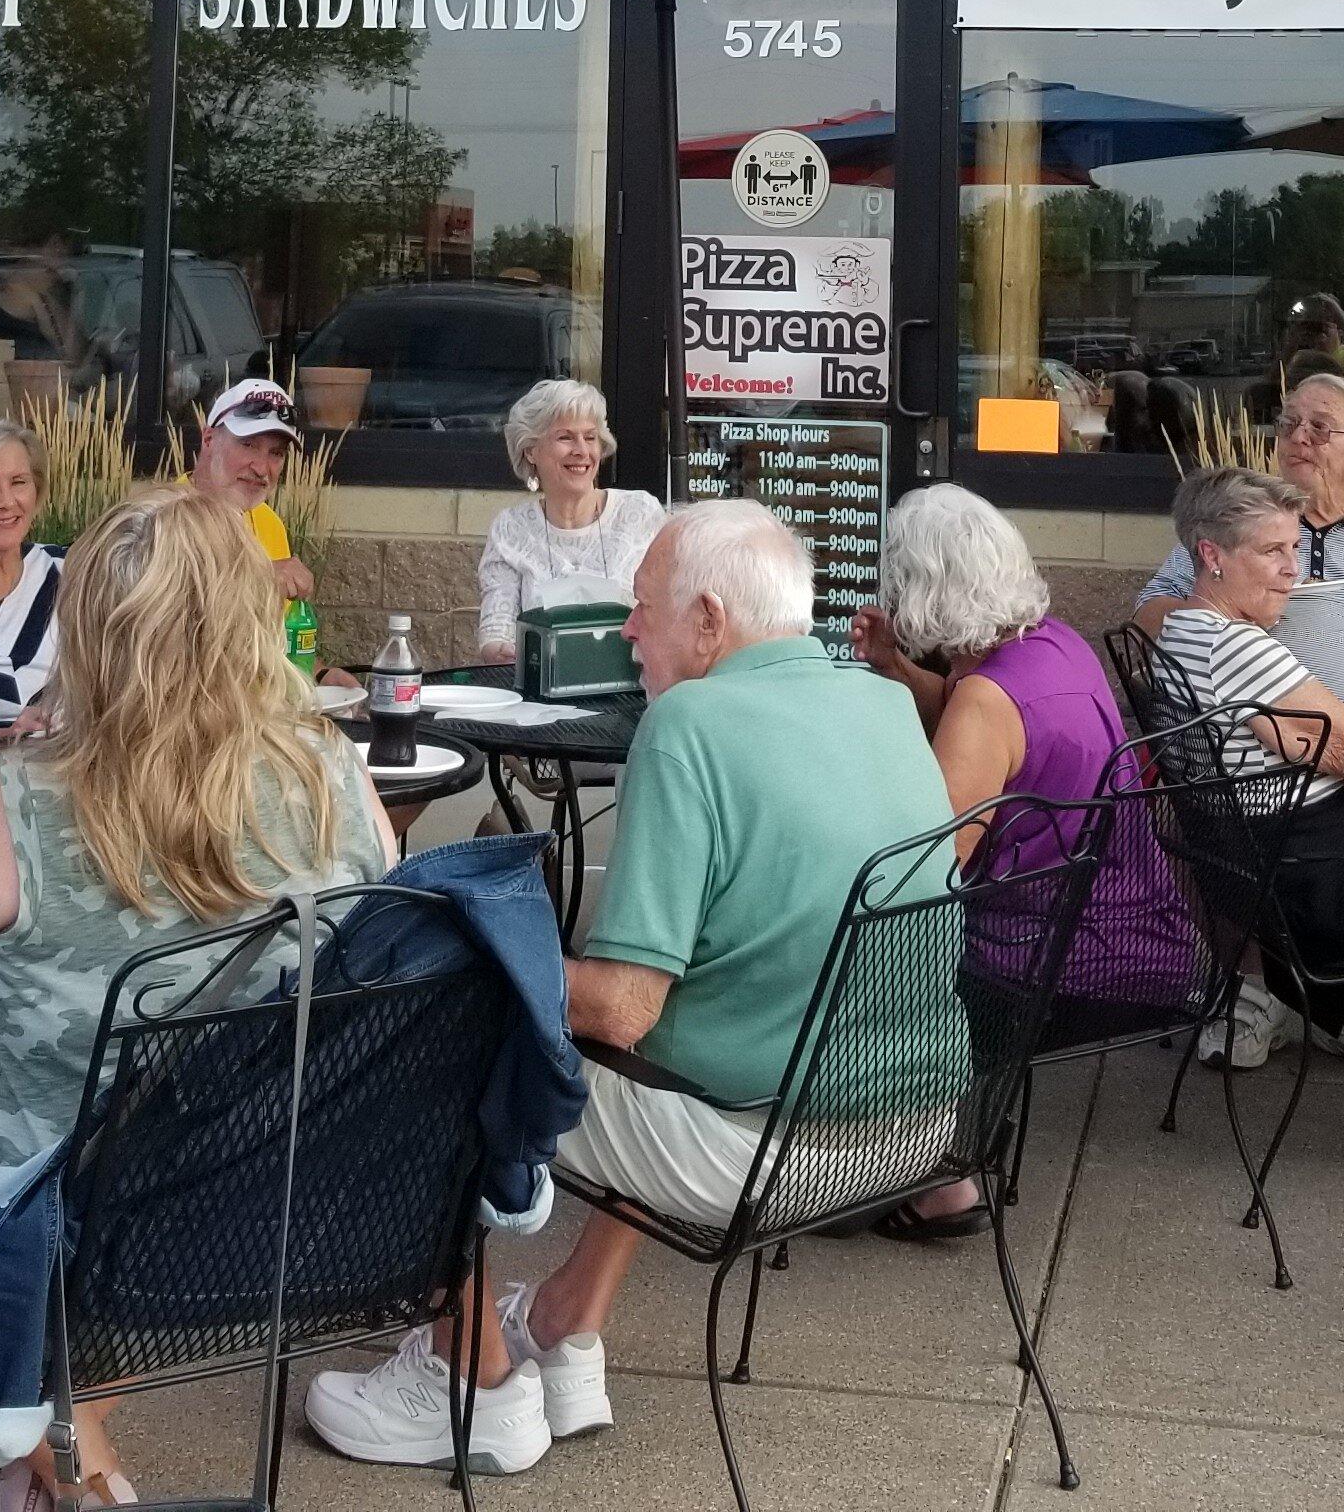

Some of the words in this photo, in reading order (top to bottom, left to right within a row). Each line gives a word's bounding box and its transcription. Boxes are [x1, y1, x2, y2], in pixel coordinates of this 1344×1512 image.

[723, 19, 843, 58] 5745
[764, 151, 796, 159] PLEASE
[747, 195, 813, 207] DISTANCE
[681, 242, 790, 286] Pizza
[683, 301, 881, 357] Supreme
[685, 372, 794, 395] Welcome!
[827, 362, 881, 395] Inc.
[720, 422, 754, 441] Pizza
[755, 423, 790, 445] Shop
[791, 424, 830, 443] Hours
[688, 448, 731, 470] onday-
[759, 450, 795, 469] 11:00
[689, 475, 731, 497] esday-
[758, 477, 794, 495] 11:00
